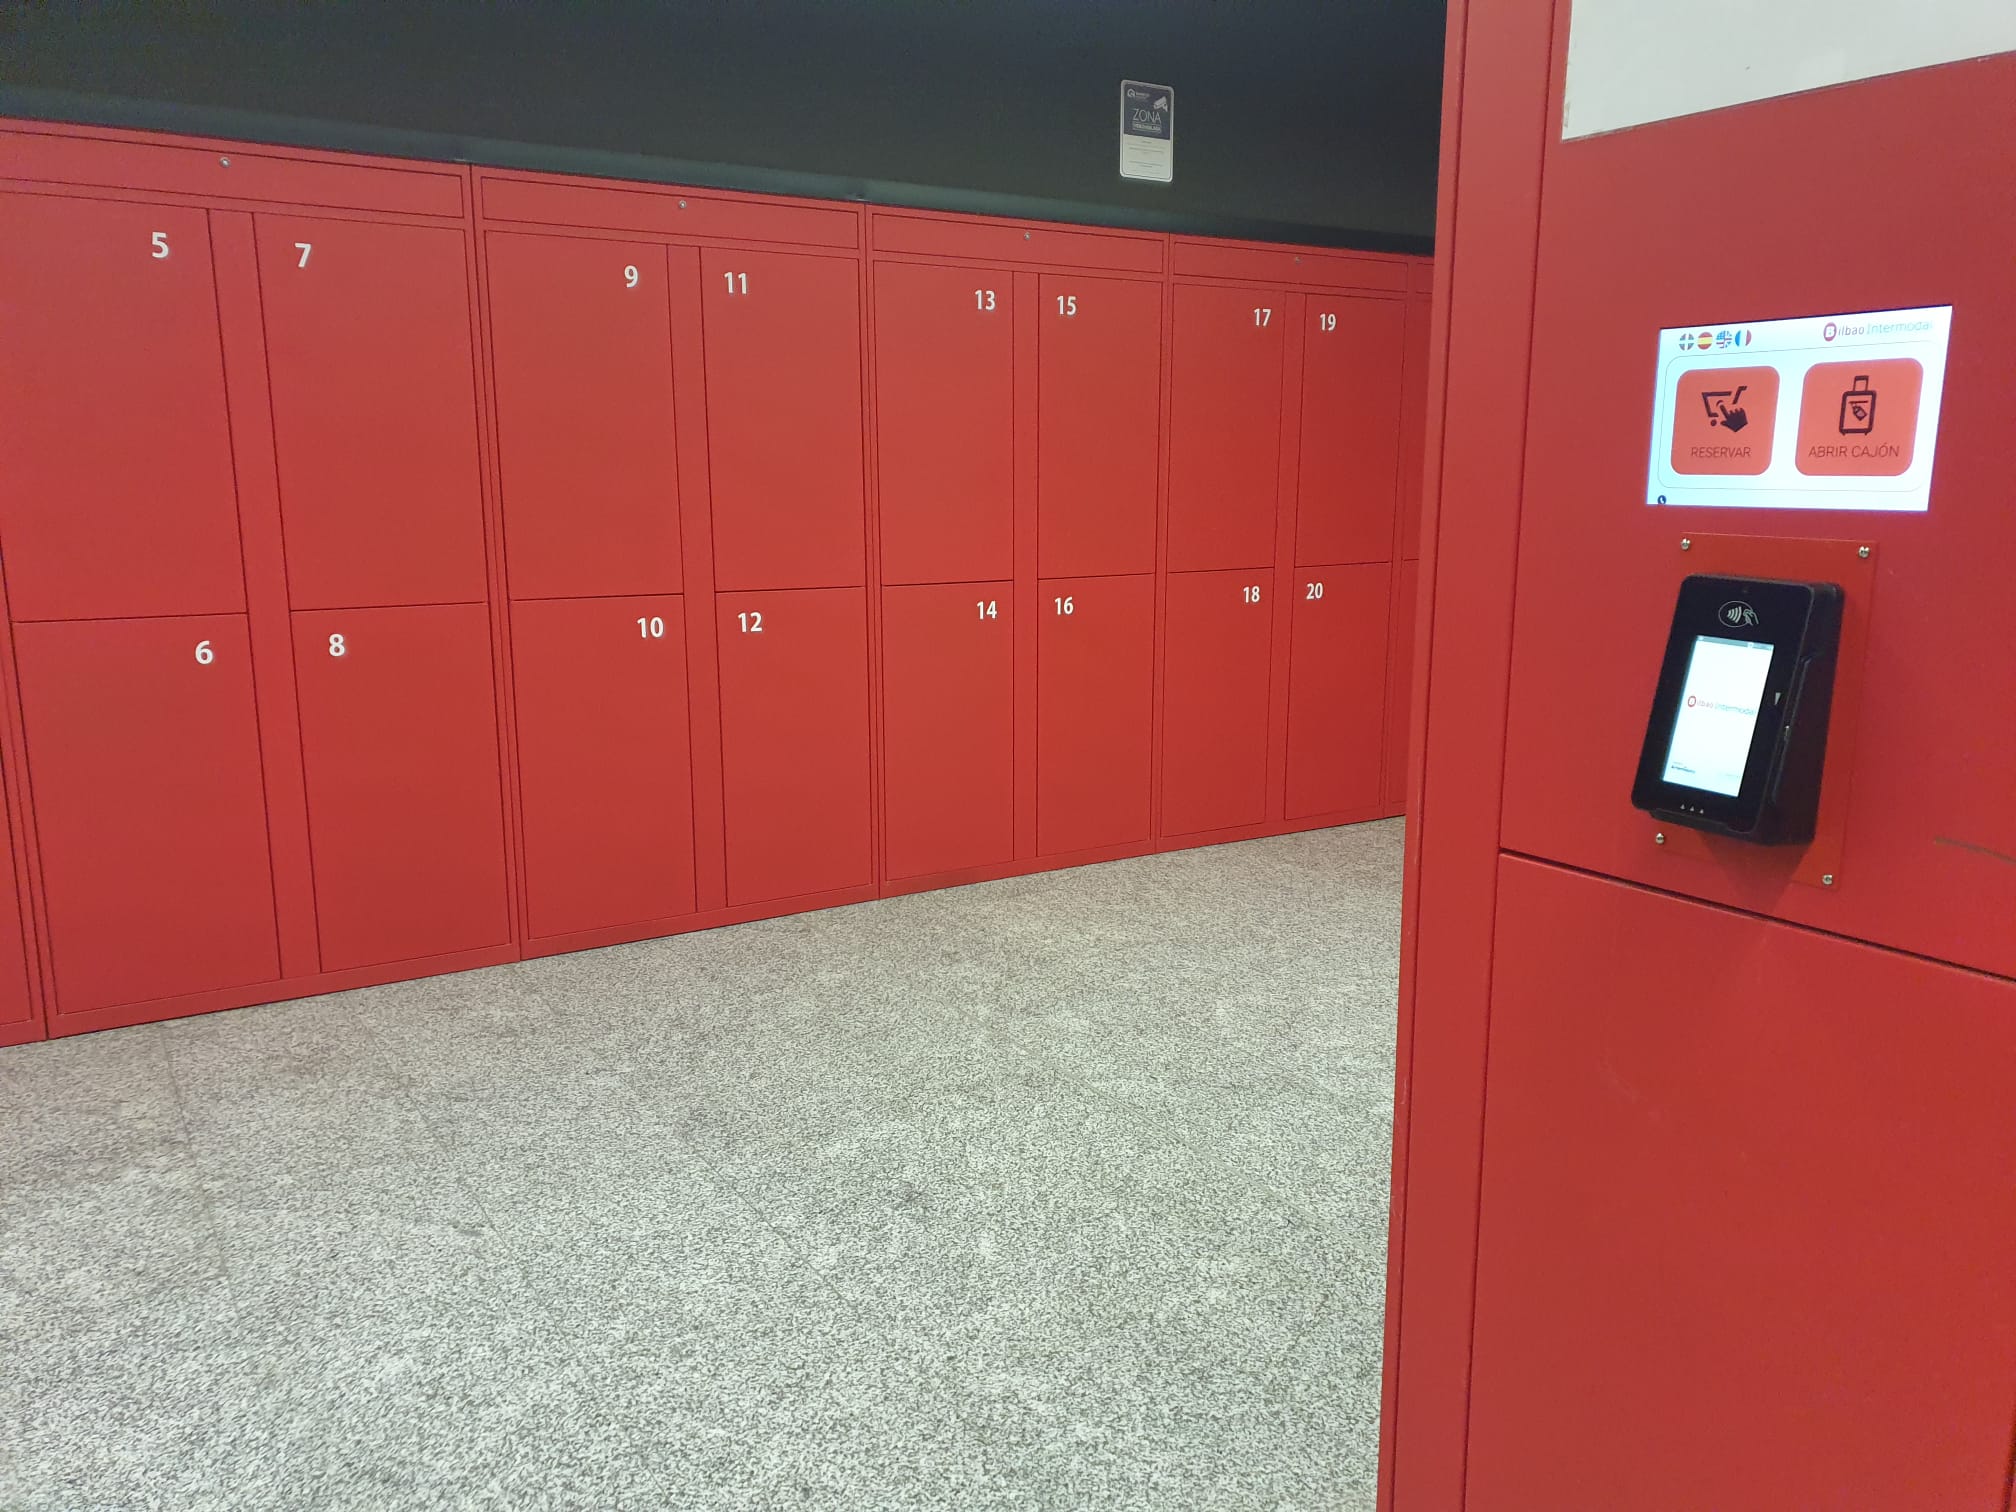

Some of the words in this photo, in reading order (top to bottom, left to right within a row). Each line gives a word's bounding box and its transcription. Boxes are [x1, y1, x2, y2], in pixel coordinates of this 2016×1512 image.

[1132, 107, 1161, 124] ZONA
[150, 231, 170, 260] 5
[294, 242, 312, 269] 7
[624, 265, 639, 289] 9
[724, 271, 748, 296] 11
[974, 289, 997, 311] 13
[1056, 296, 1077, 316] 15
[1253, 308, 1272, 327] 17
[1319, 313, 1337, 332] 19
[1691, 446, 1751, 458] RESERVAR
[1808, 446, 1848, 458] ABRIR
[1851, 442, 1900, 458] CAJÓN
[1243, 585, 1260, 604] 18
[1305, 582, 1324, 601] 20
[975, 600, 998, 620] 14
[1054, 597, 1074, 616] 16
[637, 616, 664, 639] 10
[737, 611, 763, 633] 12
[194, 640, 214, 665] 6
[328, 633, 347, 657] 8
